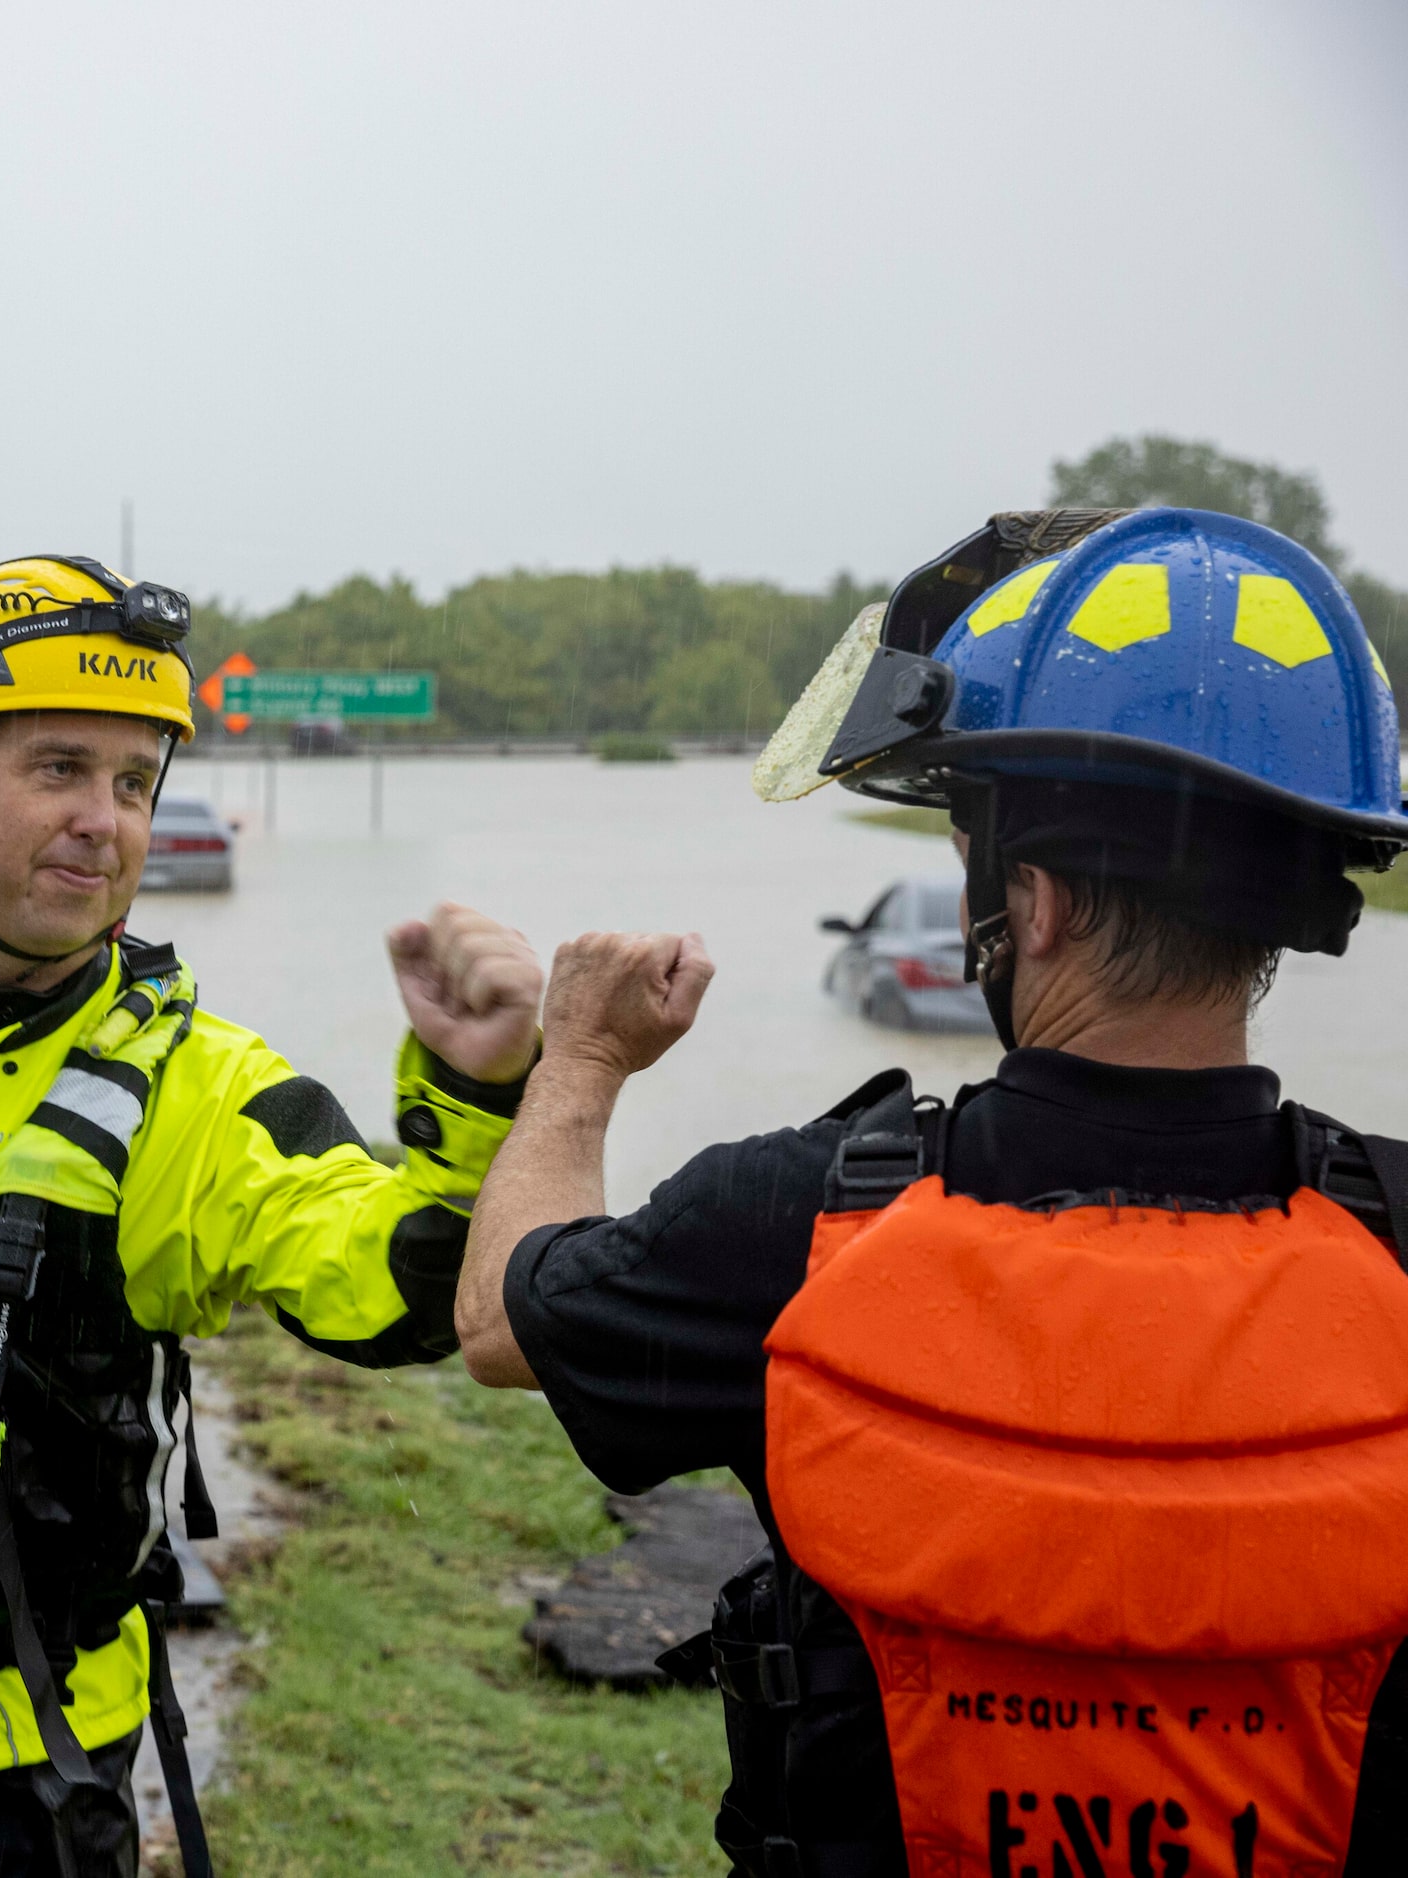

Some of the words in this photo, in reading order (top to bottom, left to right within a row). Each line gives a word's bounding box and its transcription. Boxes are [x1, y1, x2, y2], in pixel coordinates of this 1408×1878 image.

[7, 617, 69, 638] Diamond
[79, 652, 158, 683] KASK
[947, 1691, 1159, 1734] MESQUITE
[1188, 1705, 1285, 1736] F.D.
[988, 1789, 1191, 1878] ENG
